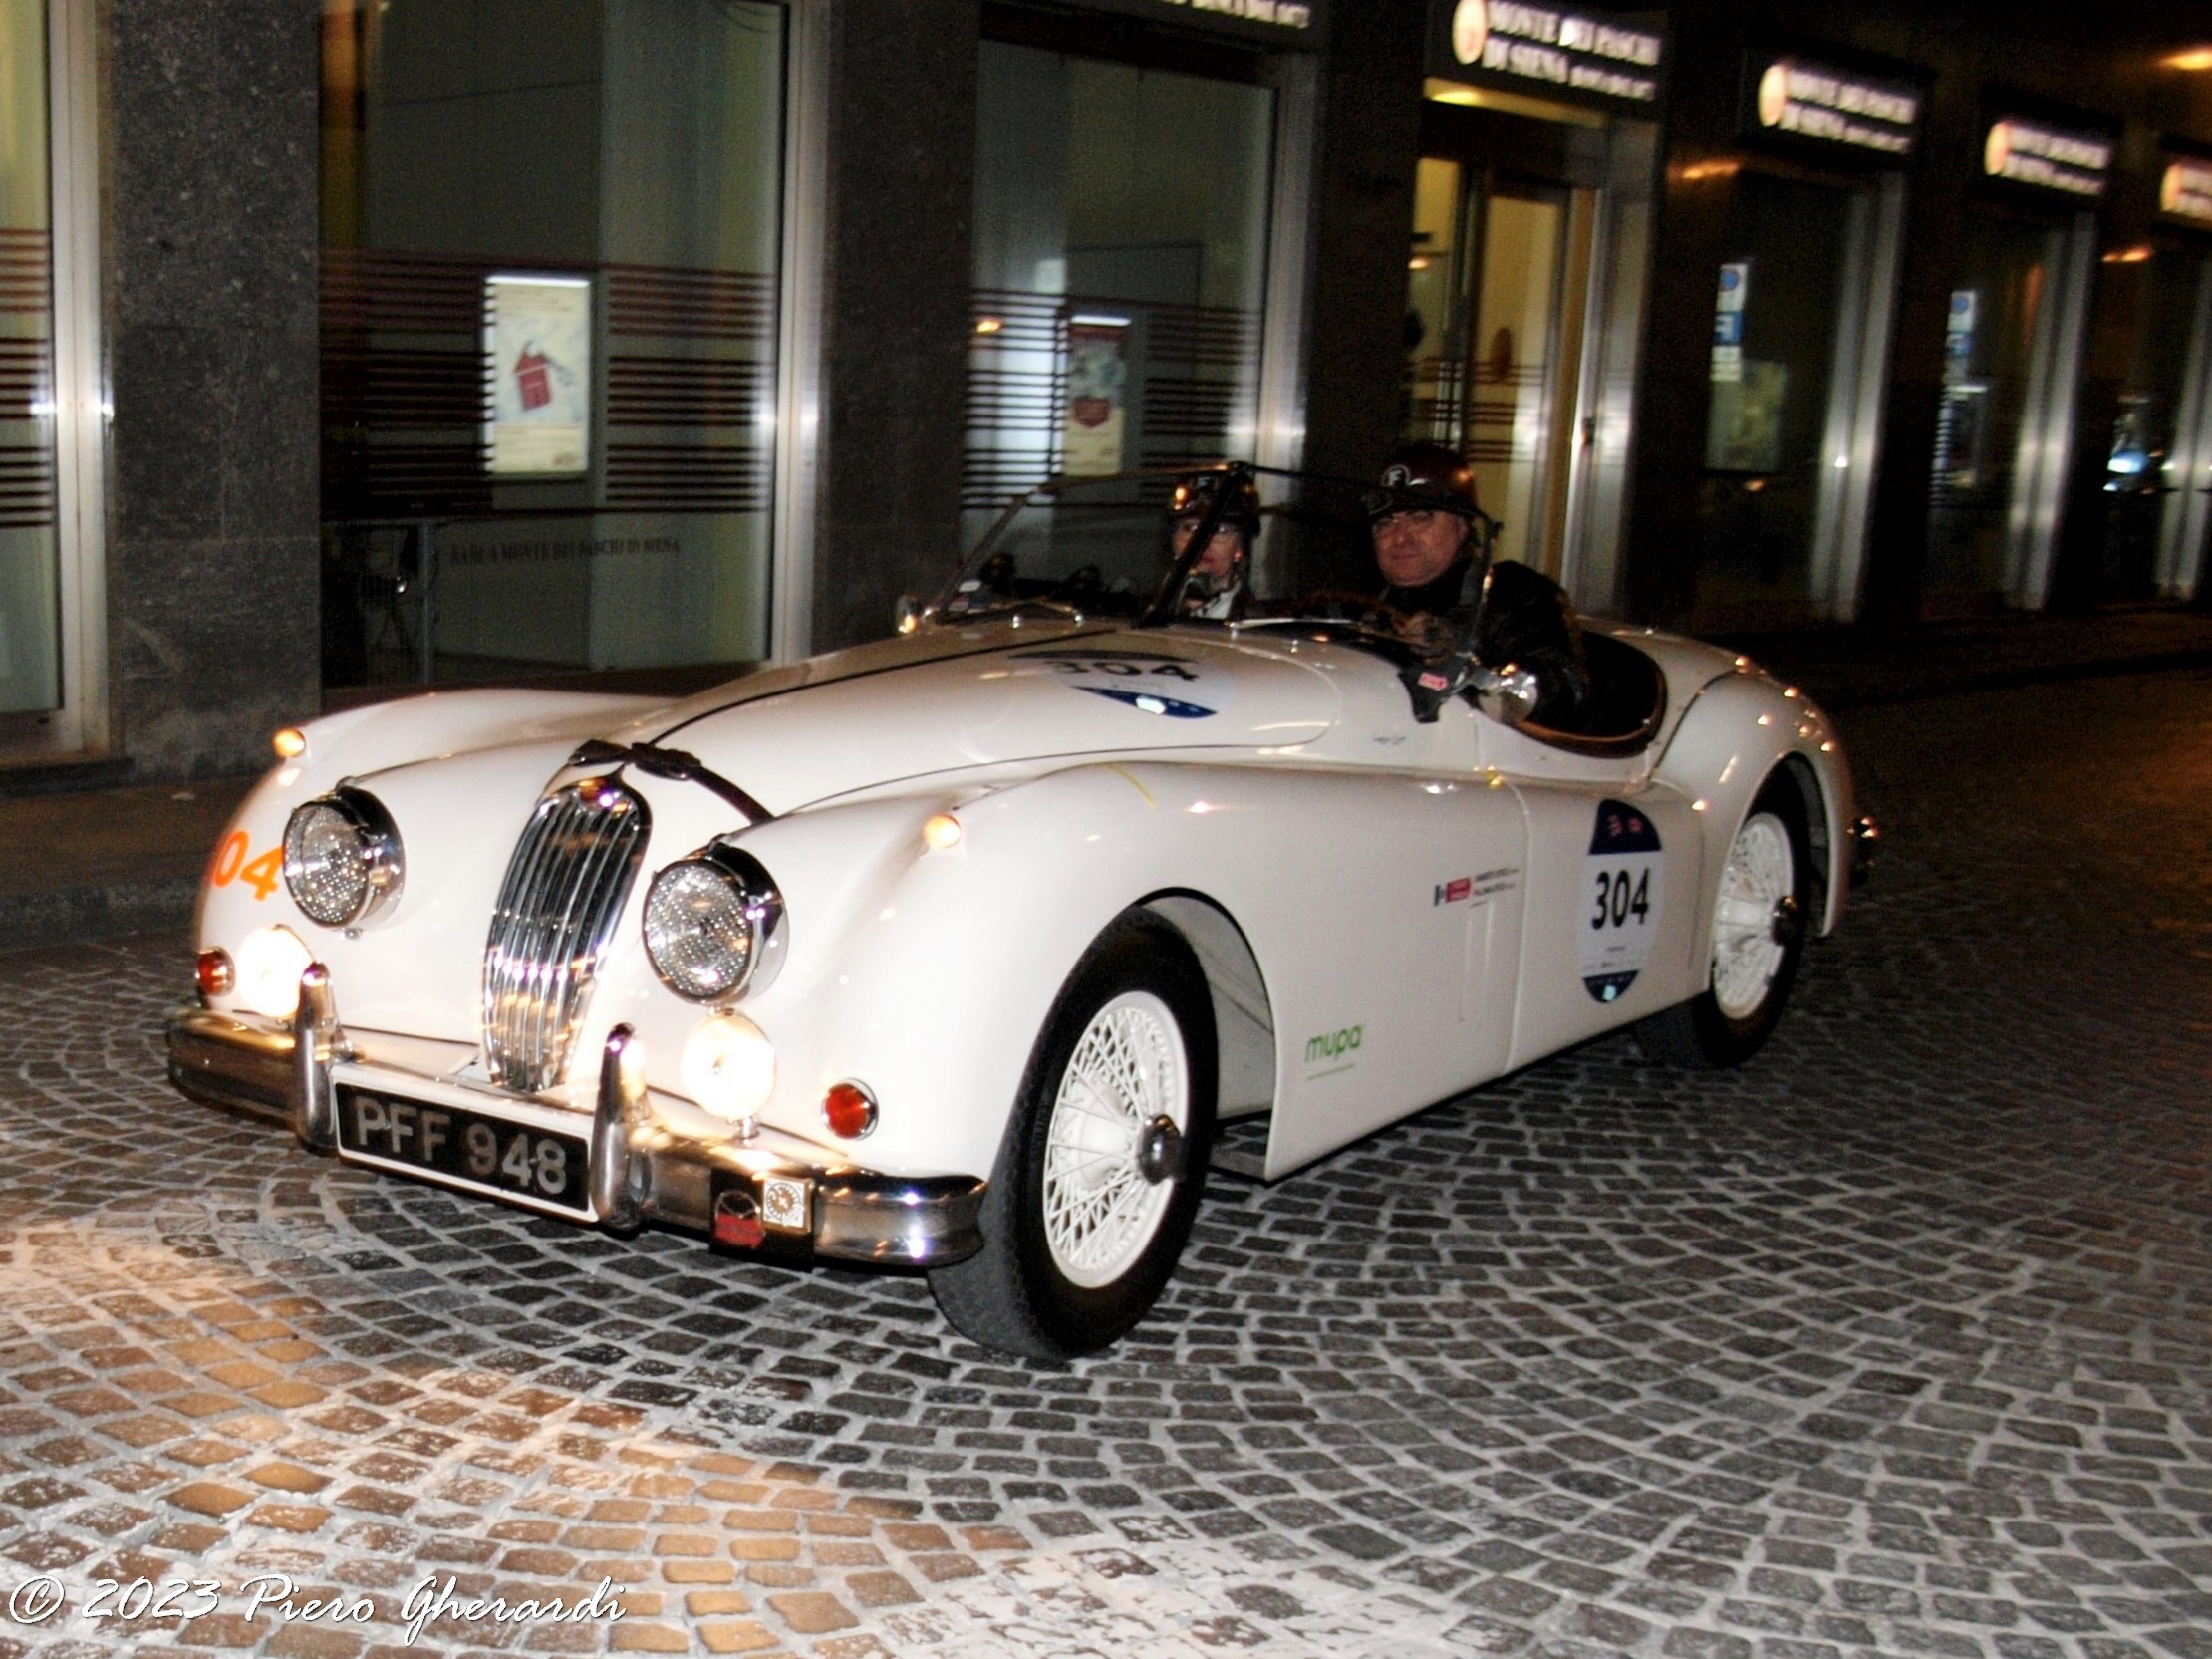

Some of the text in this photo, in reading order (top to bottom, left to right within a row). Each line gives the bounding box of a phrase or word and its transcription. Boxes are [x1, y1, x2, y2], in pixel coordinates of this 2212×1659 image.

[1591, 866, 1650, 929] 304
[355, 1096, 567, 1195] PFF 948
